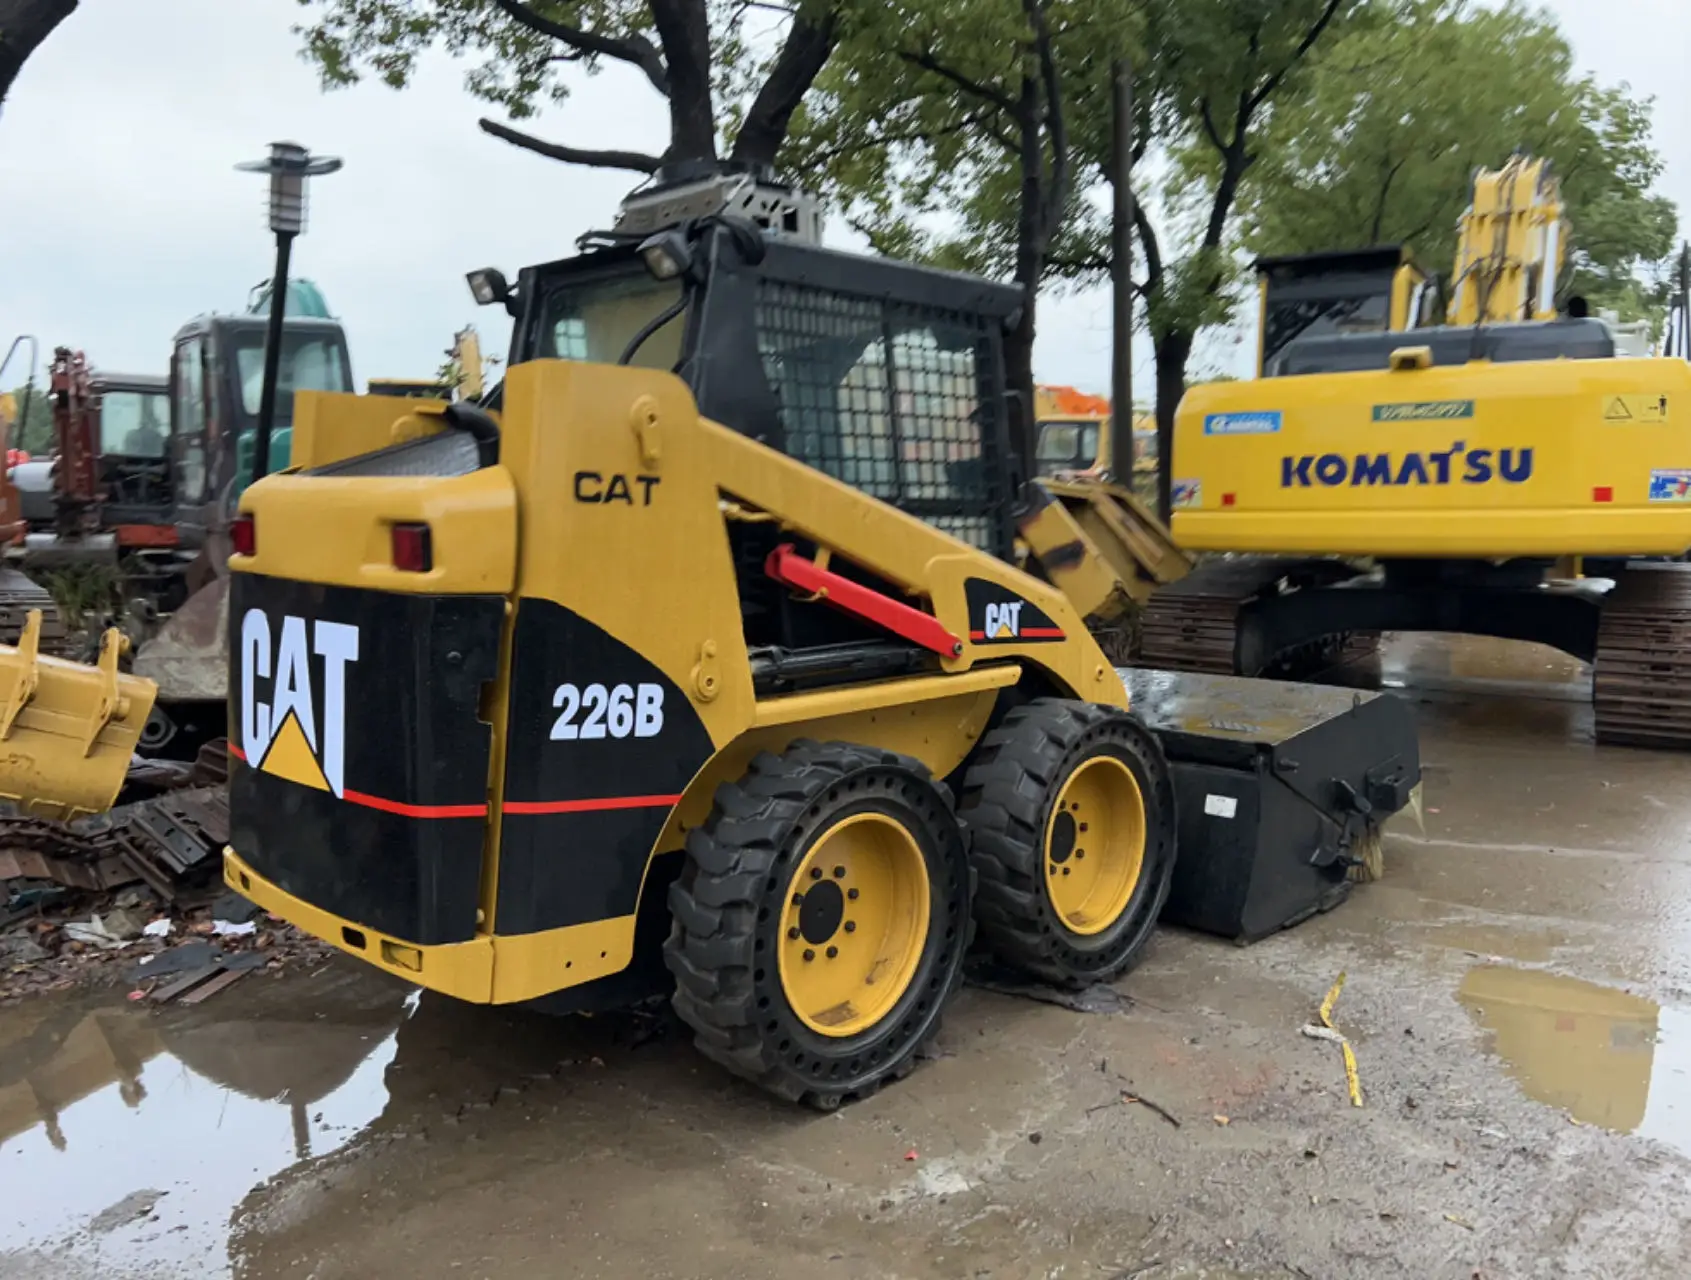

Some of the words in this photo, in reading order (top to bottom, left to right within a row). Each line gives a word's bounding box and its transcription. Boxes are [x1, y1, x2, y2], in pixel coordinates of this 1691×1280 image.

[1281, 441, 1534, 487] KOMATSU
[574, 471, 661, 506] CAT
[985, 602, 1021, 638] CAT
[241, 608, 359, 799] CAT
[550, 683, 665, 740] 226B
